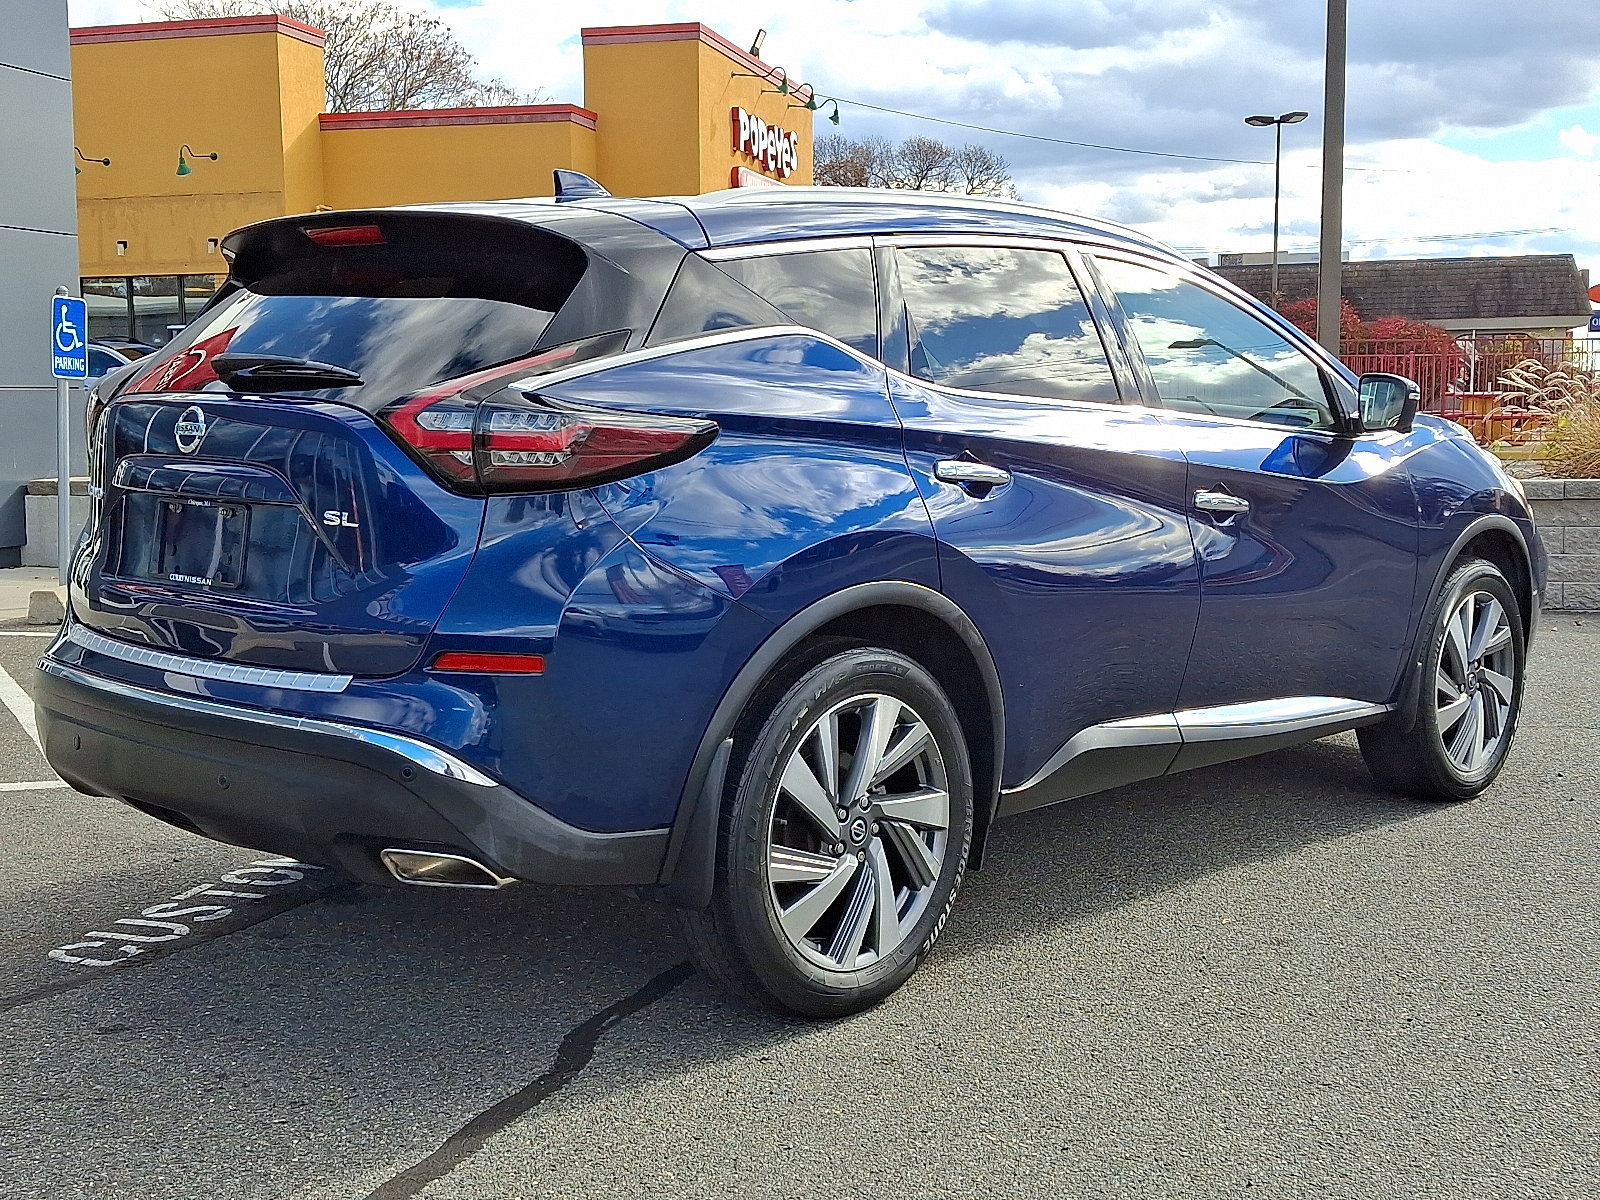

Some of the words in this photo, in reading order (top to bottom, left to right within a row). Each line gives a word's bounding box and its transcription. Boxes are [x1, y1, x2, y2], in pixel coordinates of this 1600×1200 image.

[54, 355, 85, 372] PARKING
[323, 510, 359, 528] SL
[184, 575, 212, 586] NISSAN
